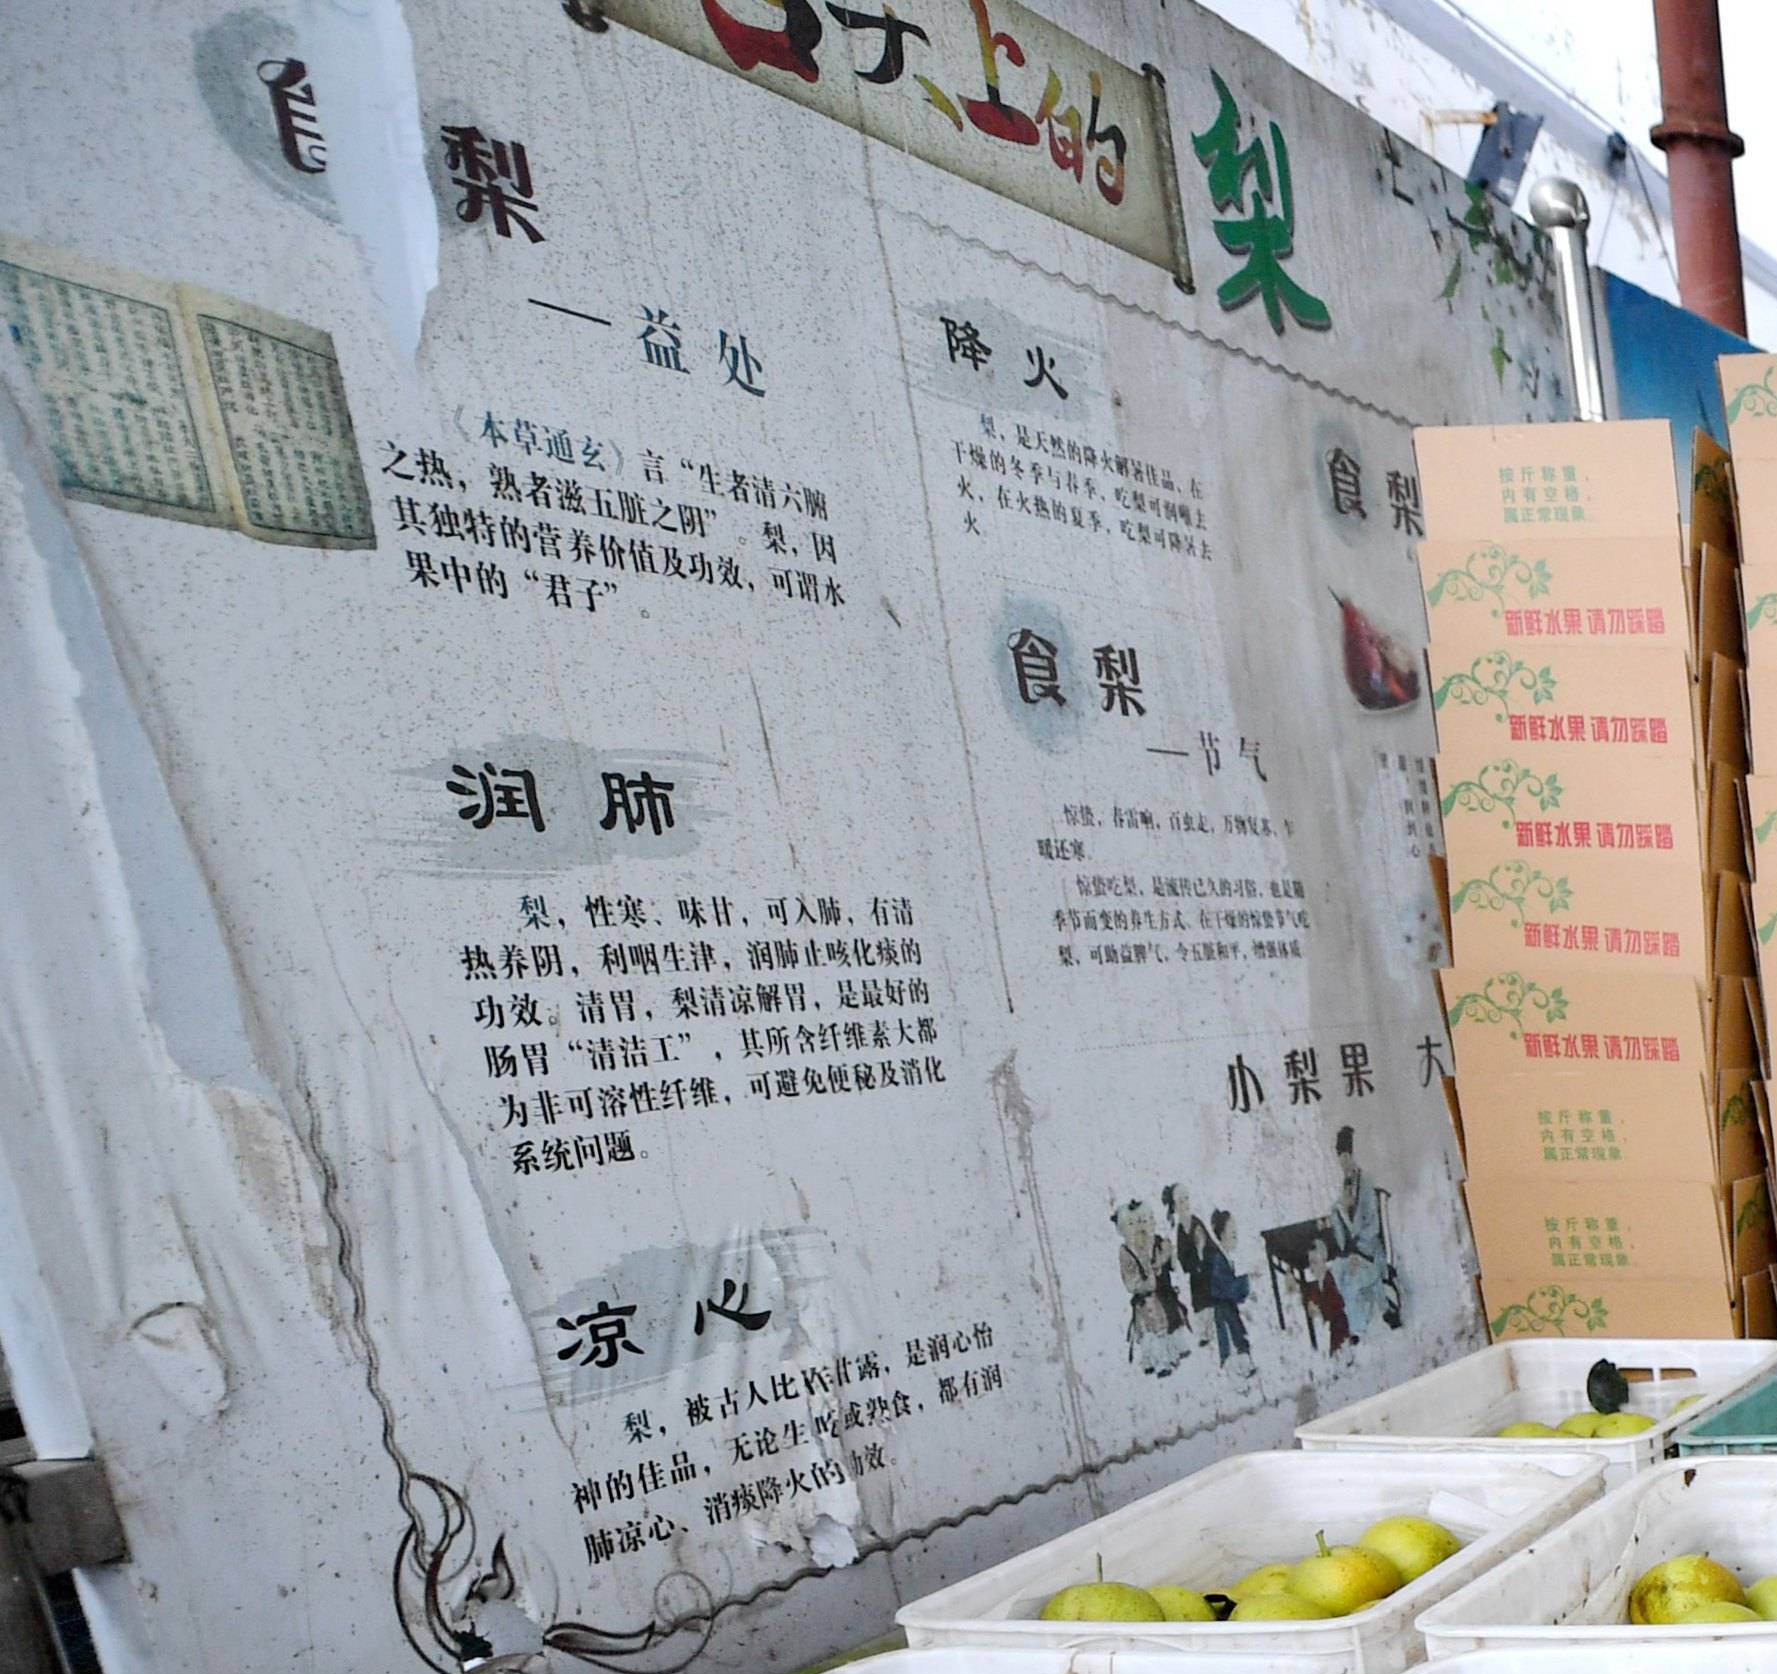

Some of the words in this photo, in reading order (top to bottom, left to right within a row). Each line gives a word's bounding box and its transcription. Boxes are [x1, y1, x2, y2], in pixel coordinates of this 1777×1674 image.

[1194, 66, 1332, 336] 梨
[941, 315, 1070, 402] 降火
[390, 496, 846, 607] 其独特的营养价值及功效，可谓水
[963, 510, 981, 536] 火
[1504, 608, 1585, 640] 新鲜水果
[1589, 608, 1667, 636] 请勿踩踏
[1007, 626, 1146, 718] 食梨
[1509, 713, 1587, 744] 新鲜水果
[1592, 715, 1671, 746] 请勿踩踏
[445, 760, 678, 837] 润肺
[1515, 819, 1594, 850] 新鲜水果
[1597, 821, 1676, 852] 请勿踩踏
[1524, 922, 1602, 953] 新鲜水果
[1606, 928, 1682, 959] 请勿踩踏
[1226, 1041, 1376, 1114] 小梨果
[1524, 1032, 1602, 1060] 新鲜水果
[1604, 1034, 1682, 1064] 请勿踩踏
[510, 1131, 651, 1177] 系统问题。
[557, 1277, 772, 1369] 凉心
